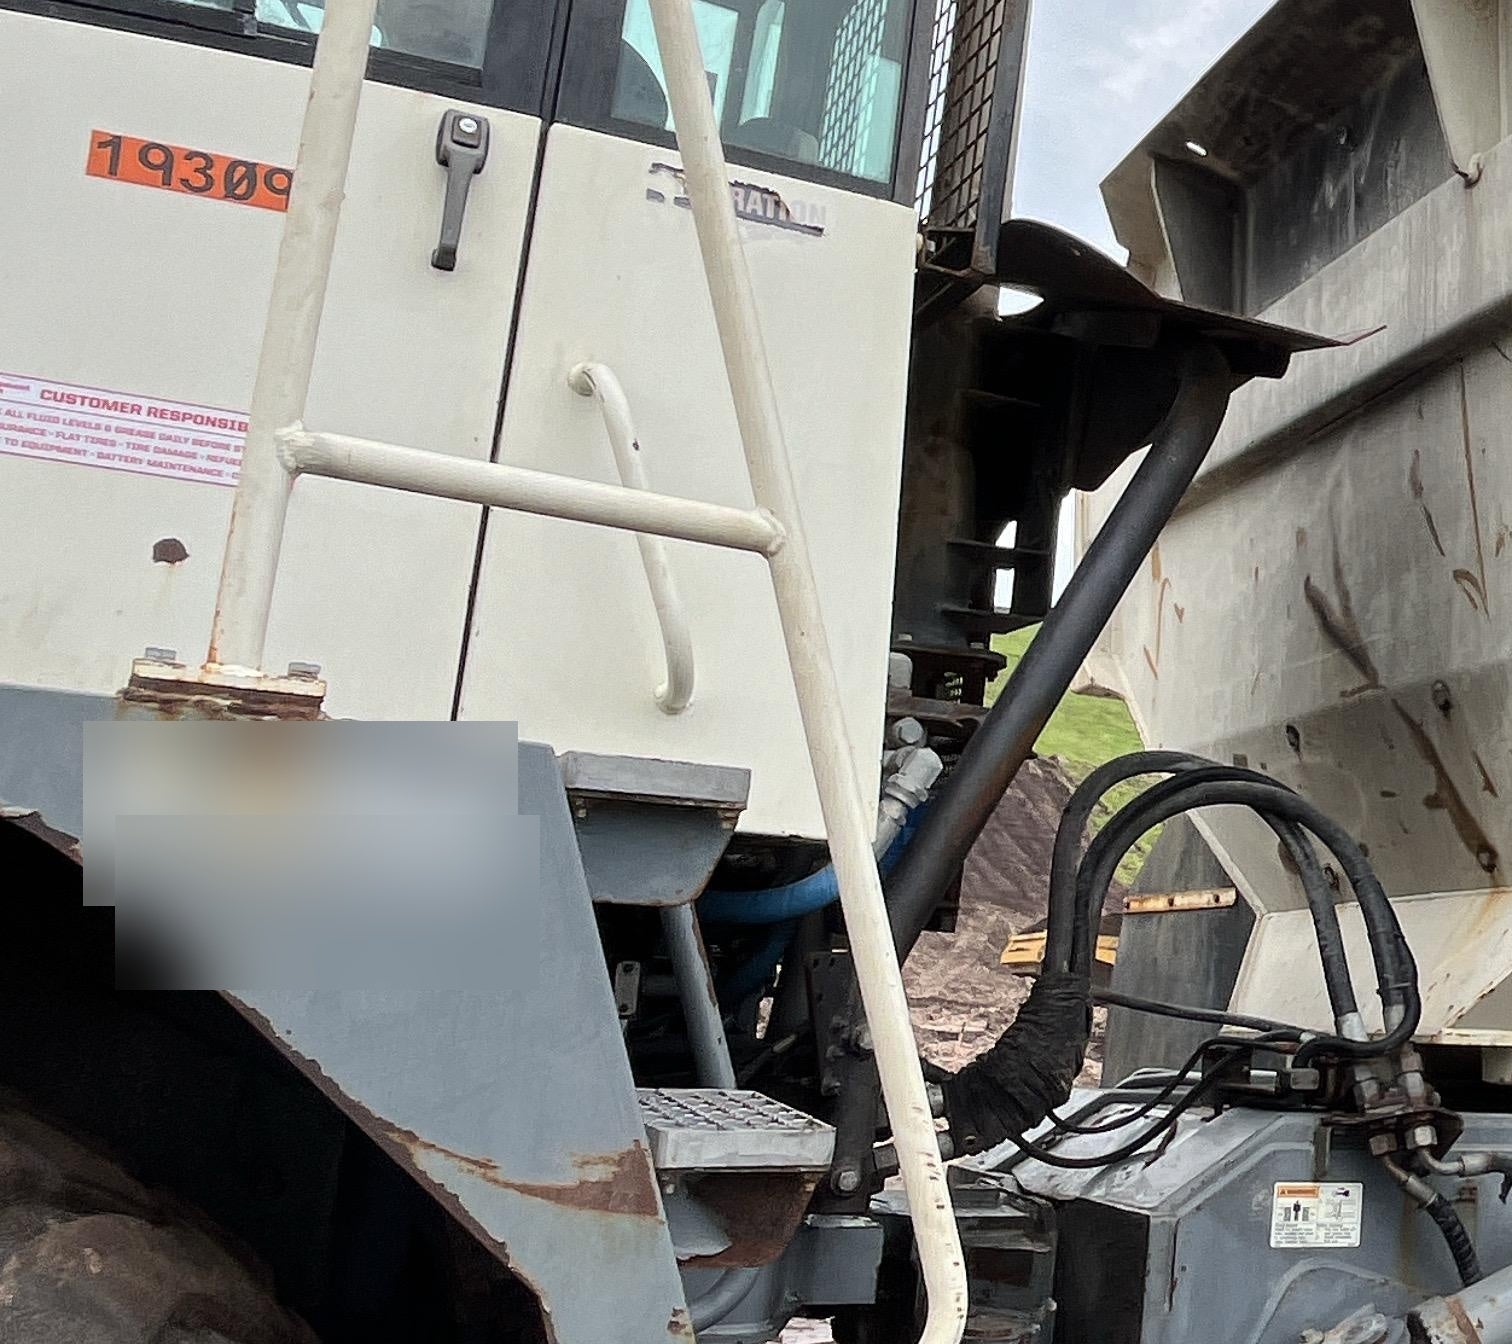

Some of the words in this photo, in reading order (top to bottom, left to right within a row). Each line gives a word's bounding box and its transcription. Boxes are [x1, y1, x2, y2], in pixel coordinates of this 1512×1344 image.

[96, 135, 293, 209] 19309
[40, 389, 143, 415] CUSTOMER
[56, 431, 81, 441] FLAT
[62, 418, 101, 430] LEVELS
[158, 432, 190, 444] DAILY
[192, 438, 231, 451] BEFORE
[147, 459, 224, 477] MAINTENANCE
